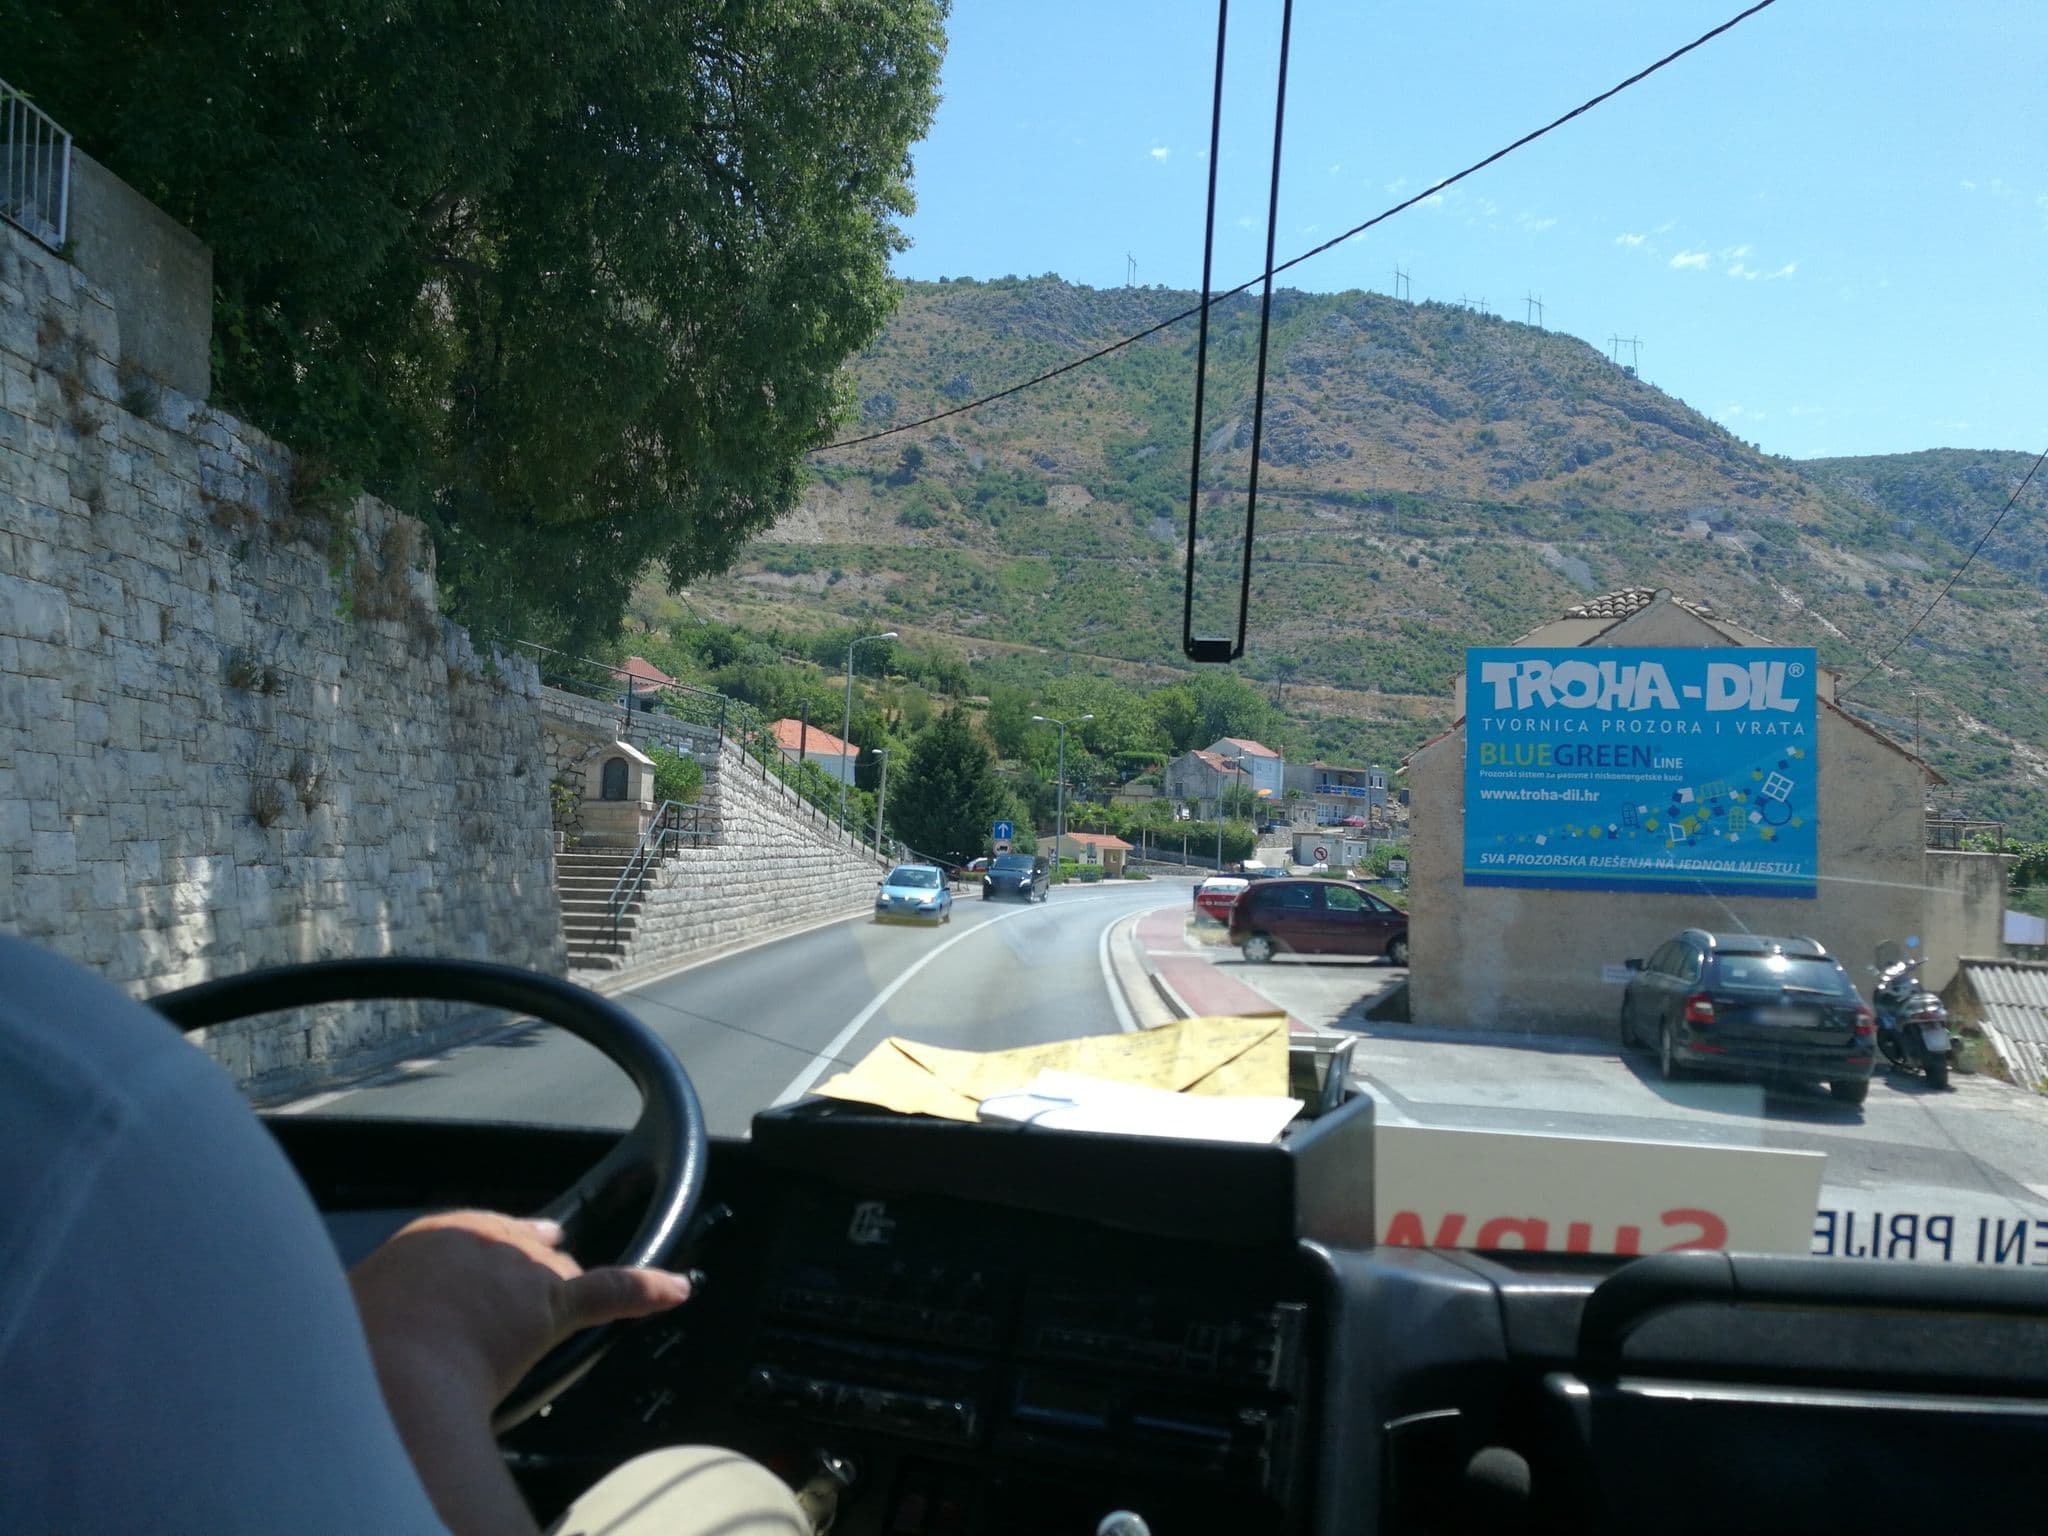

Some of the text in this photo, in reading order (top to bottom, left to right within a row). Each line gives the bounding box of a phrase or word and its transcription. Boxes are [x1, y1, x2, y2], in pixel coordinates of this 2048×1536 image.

[1482, 718, 1805, 736] TVORNICA PROZORA I VRATA
[1653, 757, 1683, 769] LINE
[1480, 769, 1516, 779] Prozorski
[1518, 770, 1545, 779] sistem
[1480, 788, 1600, 802] www.troha-dil.hr
[1480, 853, 1505, 864] SVA
[1507, 854, 1587, 867] PROZORSKA
[1589, 855, 1652, 869] RJEŠENJA
[1655, 858, 1674, 869] NA
[1679, 859, 1736, 872] JEDNOM
